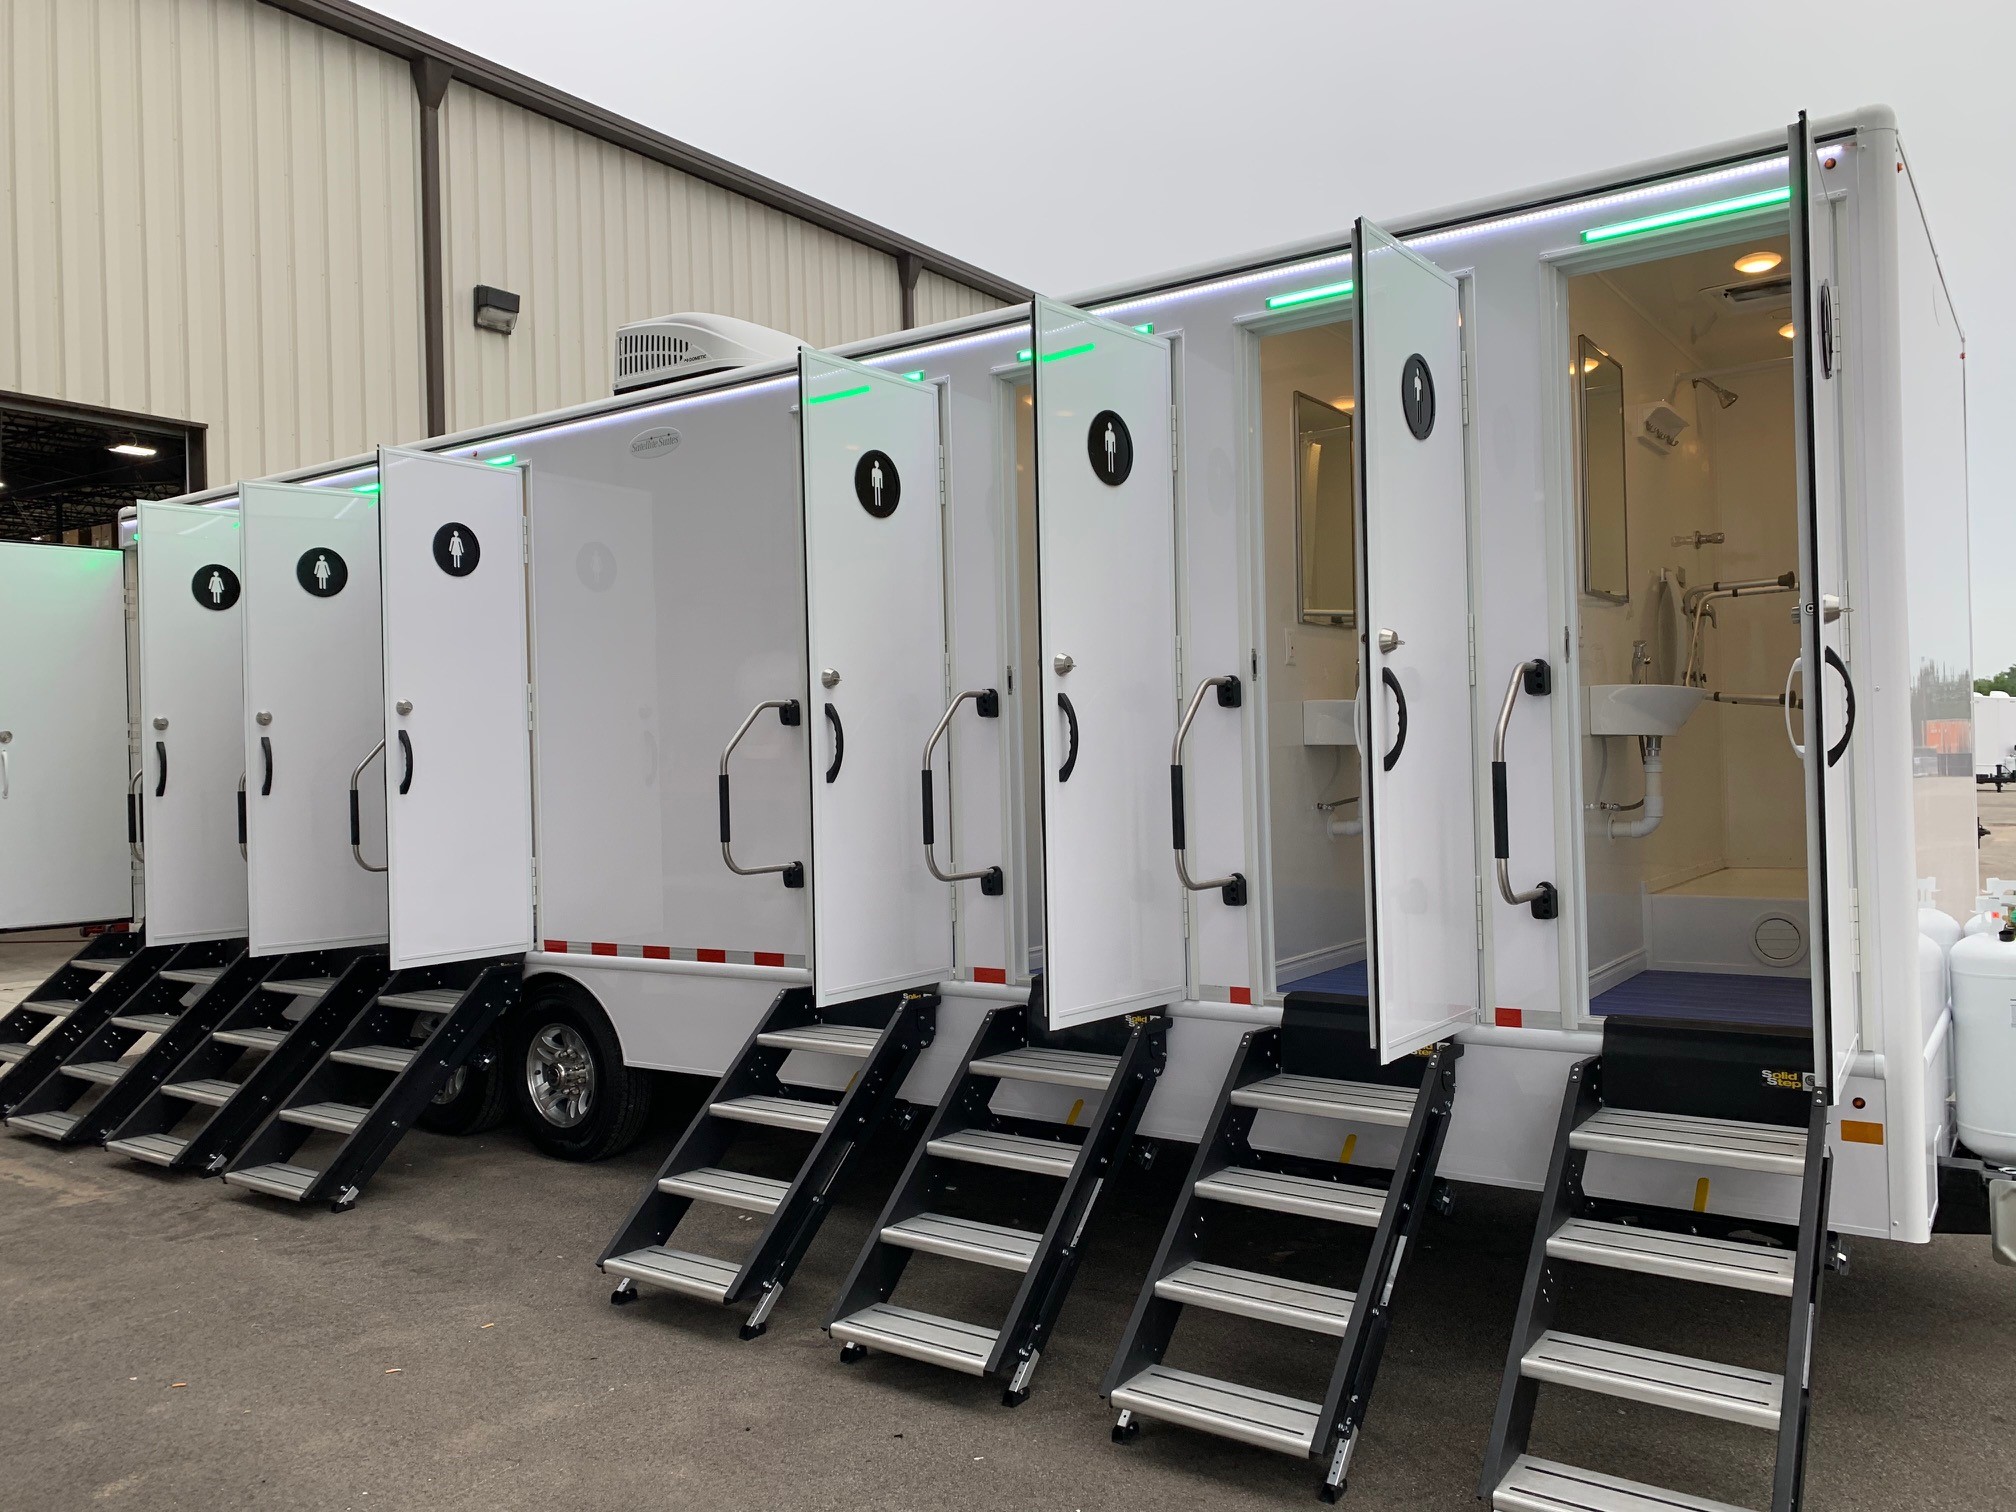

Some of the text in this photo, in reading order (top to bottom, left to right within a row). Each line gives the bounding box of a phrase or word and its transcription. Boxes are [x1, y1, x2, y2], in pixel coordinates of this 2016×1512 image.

[631, 436, 679, 453] Satellite Suites
[1761, 1069, 1798, 1080] Solid
[1767, 1077, 1802, 1089] Step
